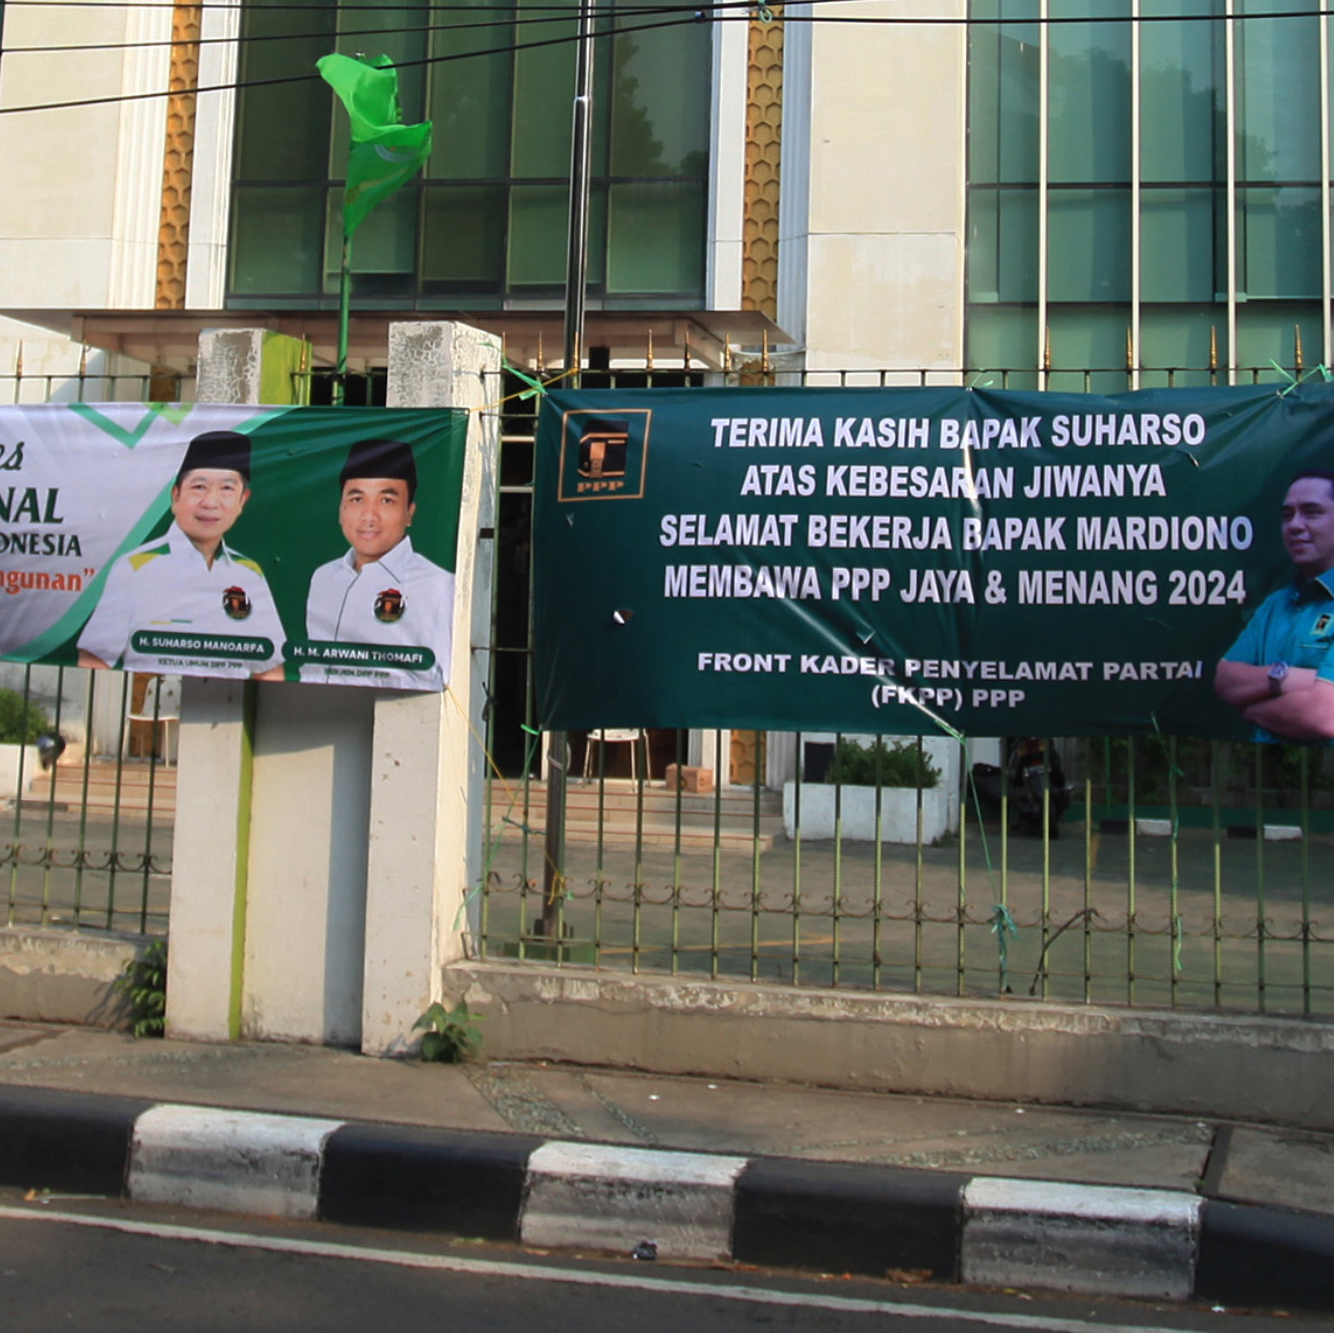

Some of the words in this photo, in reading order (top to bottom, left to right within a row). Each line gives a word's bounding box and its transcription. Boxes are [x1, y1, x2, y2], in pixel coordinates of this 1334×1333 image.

[711, 418, 824, 448] TERIMA
[834, 418, 930, 449] KASIH
[940, 416, 1042, 451] BAPAK
[1051, 413, 1206, 448] SUHARSO
[577, 481, 625, 493] PPP
[740, 465, 816, 497] ATAS
[825, 465, 1014, 499] KEBESARAN
[1023, 464, 1167, 499] JIWANYA
[659, 514, 798, 547] SELAMAT
[807, 514, 952, 549] BEKERJA
[963, 517, 1067, 551] BAPAK
[1076, 516, 1253, 551] MARDIONO
[664, 565, 821, 600] MEMBAWA
[831, 567, 891, 602] PPP
[900, 569, 975, 604] JAYA
[984, 571, 1007, 605] &
[1018, 570, 1159, 605] MENANG
[1168, 570, 1247, 605] 2024
[152, 637, 202, 650] SUHARSO
[203, 640, 265, 654] MANOARFA
[322, 648, 369, 661] ARWANI
[371, 650, 423, 664] THOMAFI
[697, 653, 792, 673] FRONT
[800, 655, 895, 676] KADER
[904, 658, 1094, 681] PENYELAMAT
[1102, 661, 1203, 681] PARTAI
[871, 684, 964, 712] (FKPP)
[972, 688, 1026, 708] PPP
